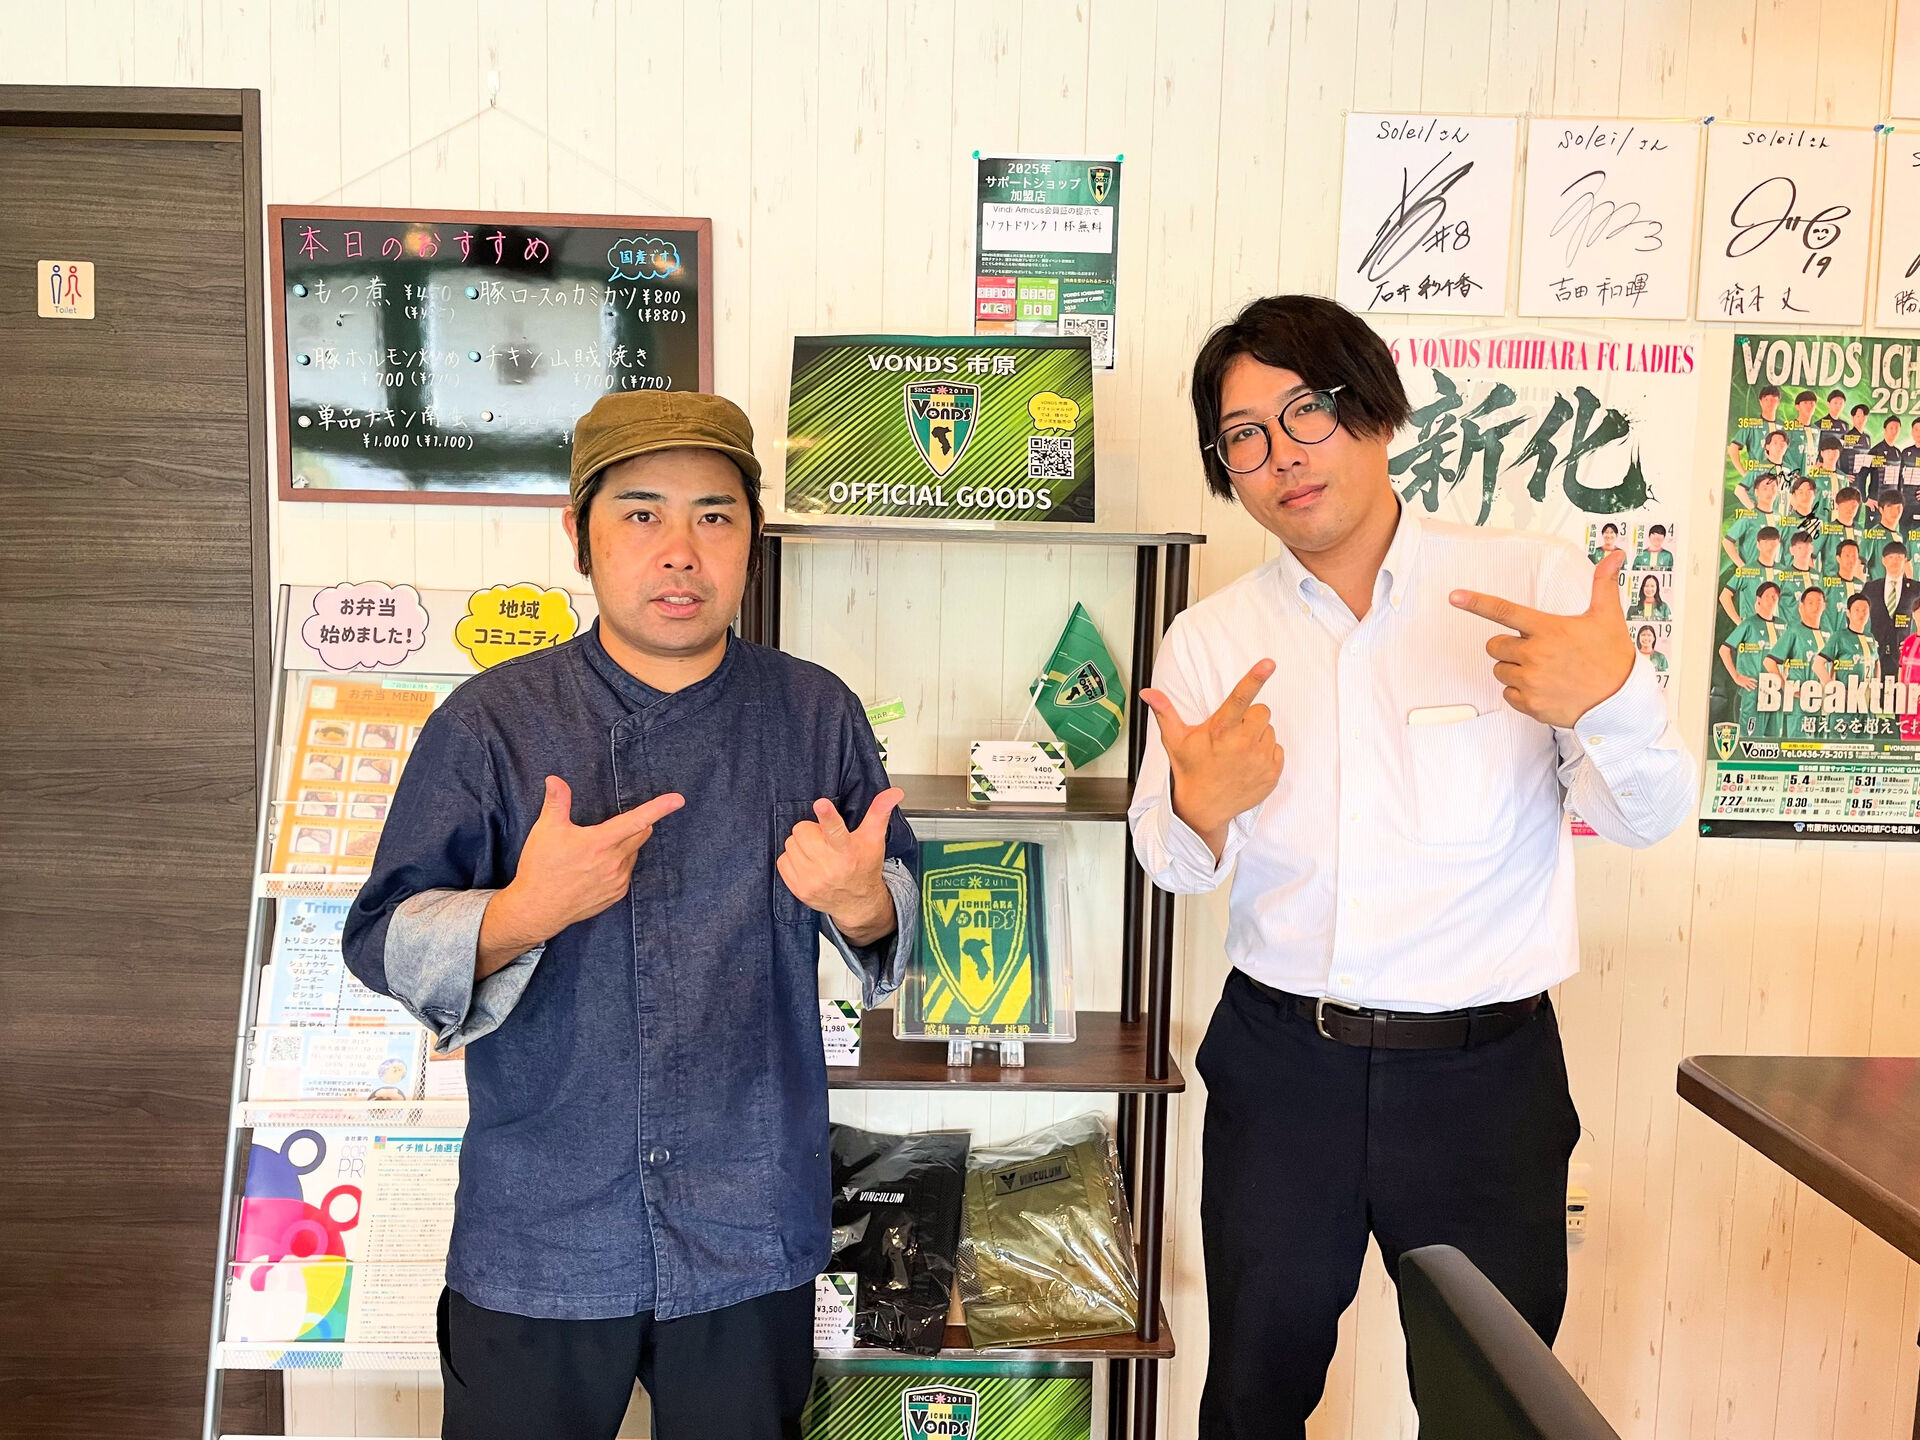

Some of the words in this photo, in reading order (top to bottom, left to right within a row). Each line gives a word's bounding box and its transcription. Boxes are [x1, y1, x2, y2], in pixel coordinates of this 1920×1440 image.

[1007, 162, 1053, 175] 2025年
[985, 175, 1082, 191] サポートショップ
[1010, 189, 1047, 203] 加盟店
[298, 225, 551, 264] 本日のおすすめ
[618, 248, 671, 267] 国産です
[642, 288, 681, 305] ¥800
[54, 306, 77, 314] Toilet
[638, 308, 687, 325] (¥880)
[485, 341, 648, 370] チキン山賊焼き
[1409, 338, 1482, 369] VONDS
[1487, 339, 1589, 372] ICHIHARA
[1596, 341, 1621, 373] FC
[1625, 342, 1695, 375] LADIES
[1742, 339, 1864, 388] VONDS
[867, 354, 958, 374] VONDS
[966, 355, 1017, 376] 市原
[621, 374, 673, 391] (¥770)
[911, 399, 973, 421] VONDS
[1388, 368, 1659, 526] 新化
[828, 481, 949, 507] OFFICIAL
[956, 486, 1052, 510] GOODS
[340, 597, 396, 618] お弁当
[499, 599, 540, 620] 地域
[320, 625, 413, 645] 始めました!
[474, 628, 560, 647] コミュニティ
[1658, 623, 1672, 638] 19
[349, 688, 385, 701] お弁当
[392, 692, 428, 702] MENU
[991, 755, 1038, 763] ミニフラッグ
[1723, 773, 1744, 785] 4.6
[1790, 774, 1810, 786] 5.4
[1855, 776, 1877, 787] 5.31
[1719, 795, 1743, 806] 7.27
[1786, 797, 1808, 808] 8.30
[935, 877, 967, 889] SINCE
[821, 1025, 846, 1033] 1,980
[338, 1158, 366, 1179] PR
[1018, 1163, 1063, 1187] VINCULUM
[859, 1191, 905, 1204] VINCULUM
[816, 1305, 843, 1315] ¥3,500
